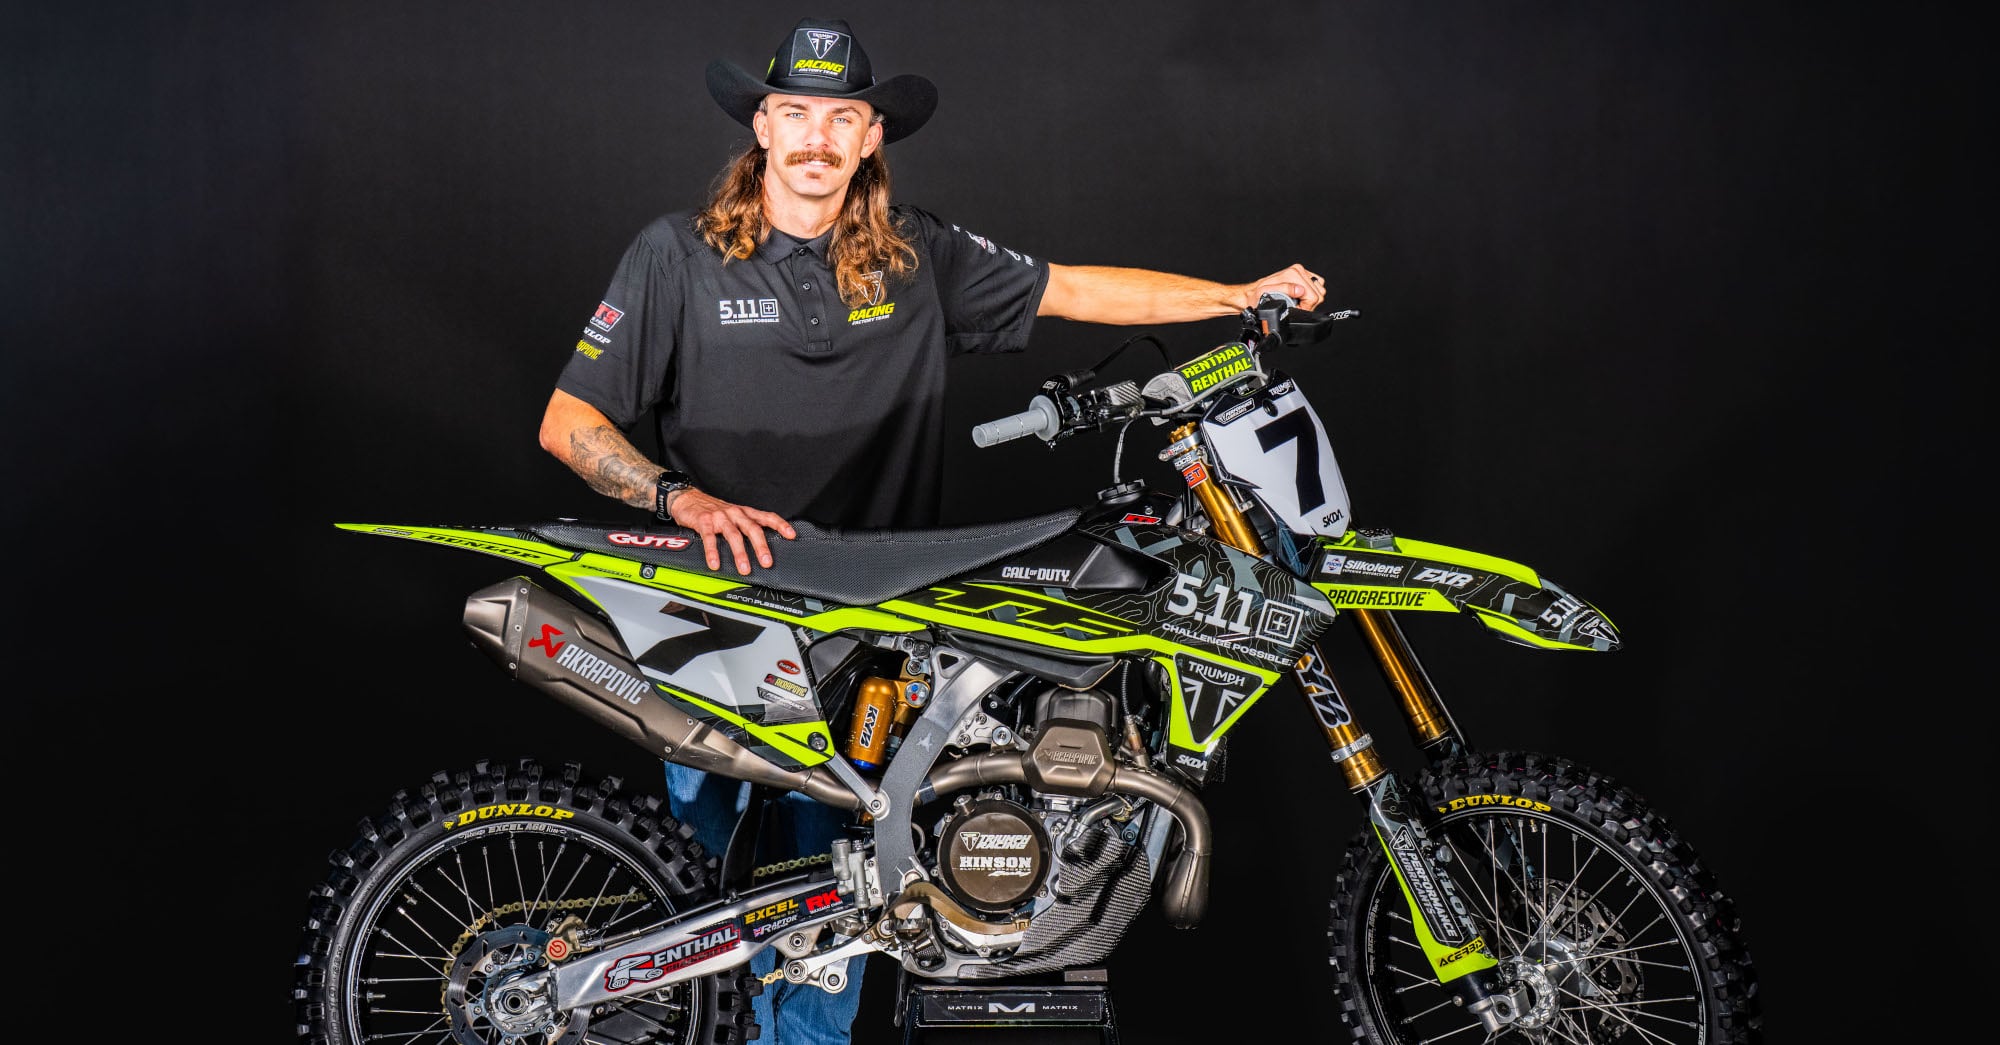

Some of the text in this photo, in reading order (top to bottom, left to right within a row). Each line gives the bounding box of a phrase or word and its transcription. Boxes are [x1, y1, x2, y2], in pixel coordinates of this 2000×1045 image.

[794, 60, 845, 73] RACING
[720, 299, 759, 319] 5.11
[848, 303, 895, 322] RACING
[1181, 345, 1245, 378] RENTHAL
[1191, 357, 1252, 393] RENTHAL
[1254, 406, 1326, 517] 7
[423, 535, 541, 559] DUNLOP
[608, 532, 690, 550] GUTS
[1001, 566, 1031, 580] CALL
[1344, 560, 1402, 574] Silkolene
[1412, 567, 1474, 588] FXR
[1167, 572, 1254, 636] 5.11
[1328, 589, 1427, 606] PROGRESSIVE
[636, 601, 766, 675] 7
[1161, 623, 1290, 666] CHALLENGE POSSIBLE
[1188, 661, 1246, 688] TRIUMPH
[860, 703, 879, 748] KYB
[1449, 793, 1552, 812] DUNLOP
[457, 803, 575, 827] DUNLOP
[488, 823, 524, 834] EXCEL
[959, 856, 1032, 868] HINSON
[1397, 850, 1436, 915] LUBRICANTS
[1407, 852, 1458, 937] PERFORMANCE
[744, 899, 799, 925] EXCEL
[805, 889, 842, 912] RK
[760, 914, 798, 935] RAPTOR
[607, 927, 738, 989] RENTHAL
